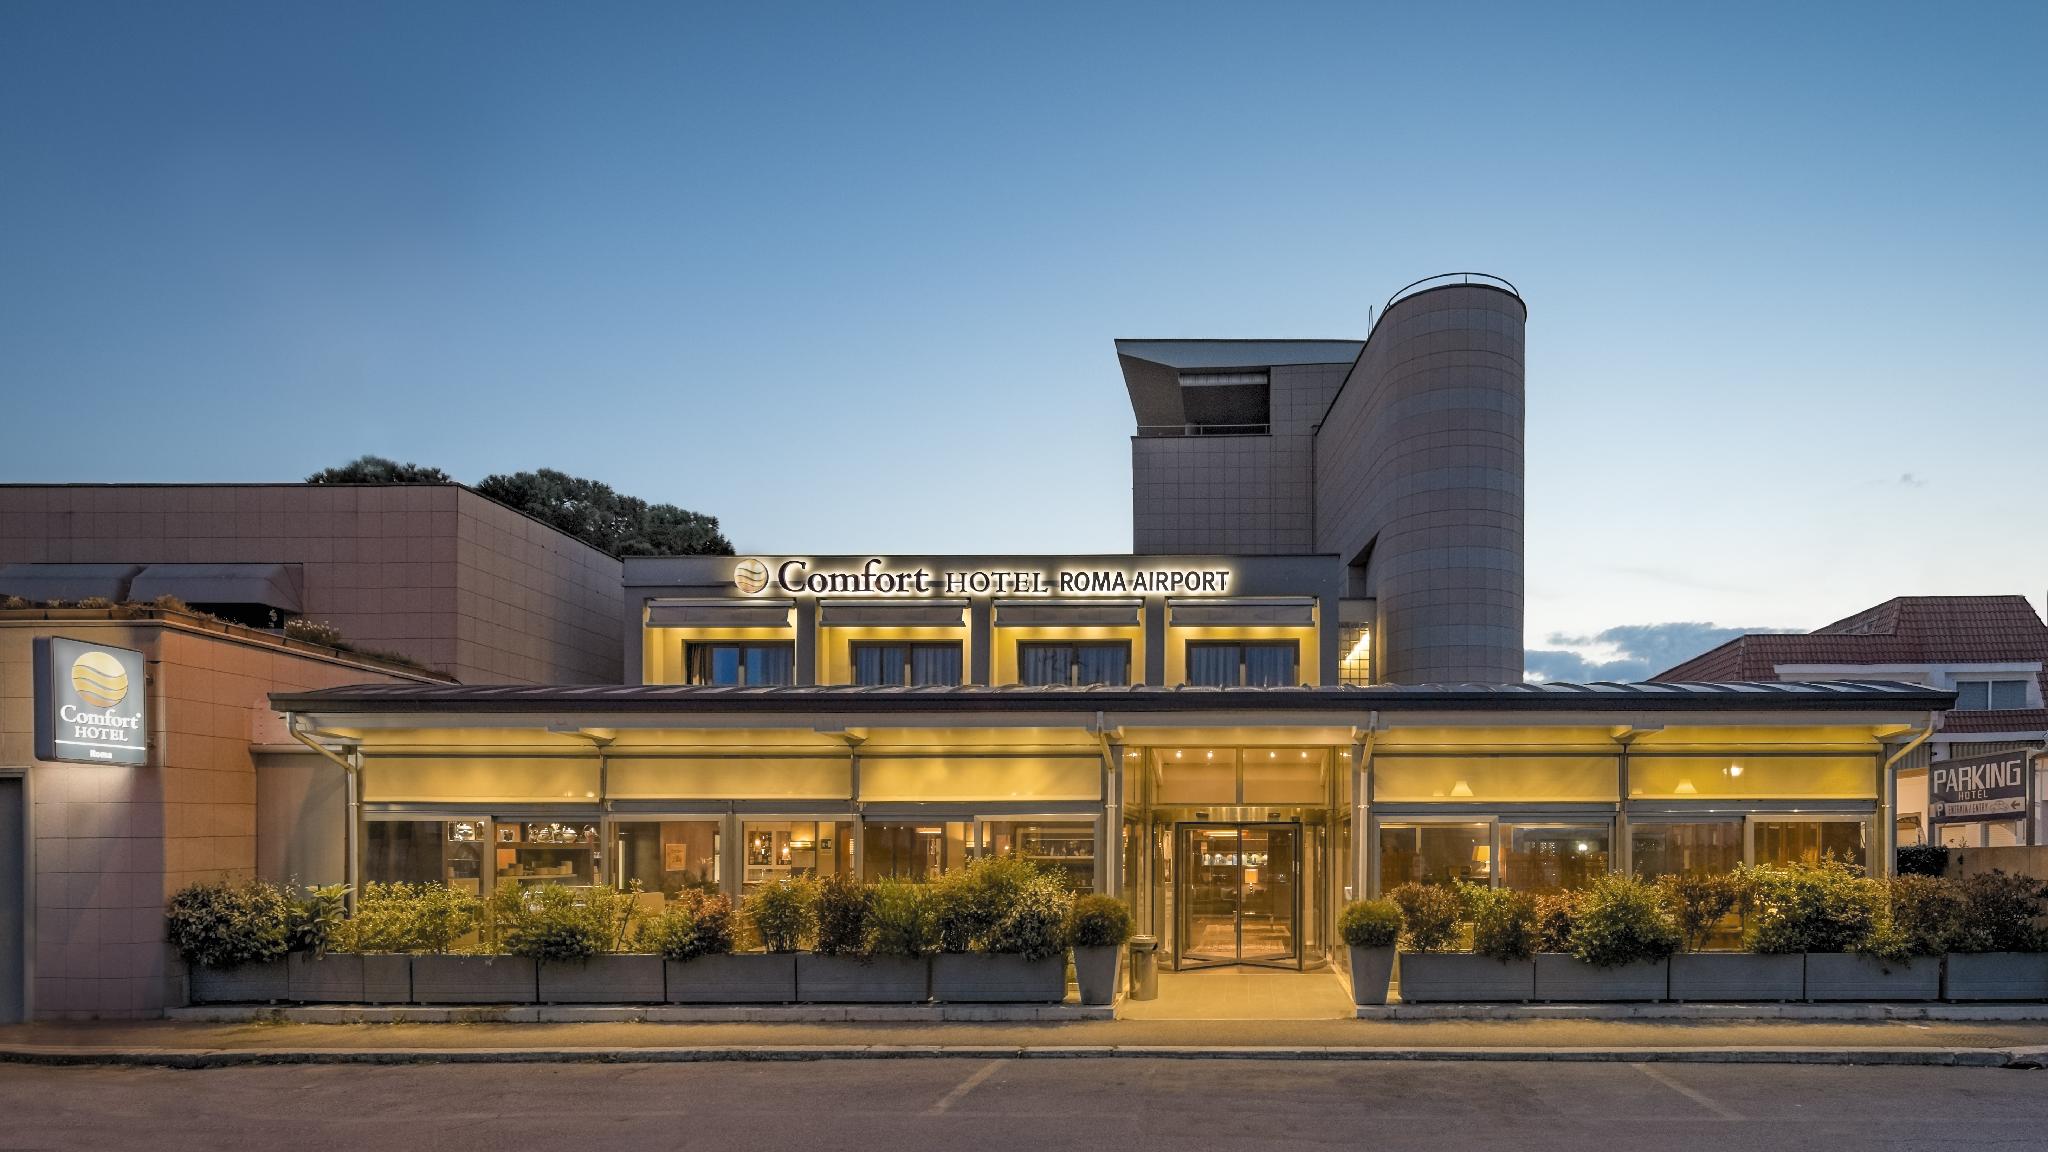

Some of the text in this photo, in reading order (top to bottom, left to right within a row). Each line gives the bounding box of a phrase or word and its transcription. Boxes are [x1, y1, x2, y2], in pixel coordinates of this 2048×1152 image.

[778, 558, 1230, 593] Comfort HOTEL ROMA AIRPORT
[60, 704, 139, 729] Comfort
[74, 725, 128, 742] HOTEL
[1933, 760, 2021, 794] PARKING
[1958, 790, 1988, 800] HOTEL
